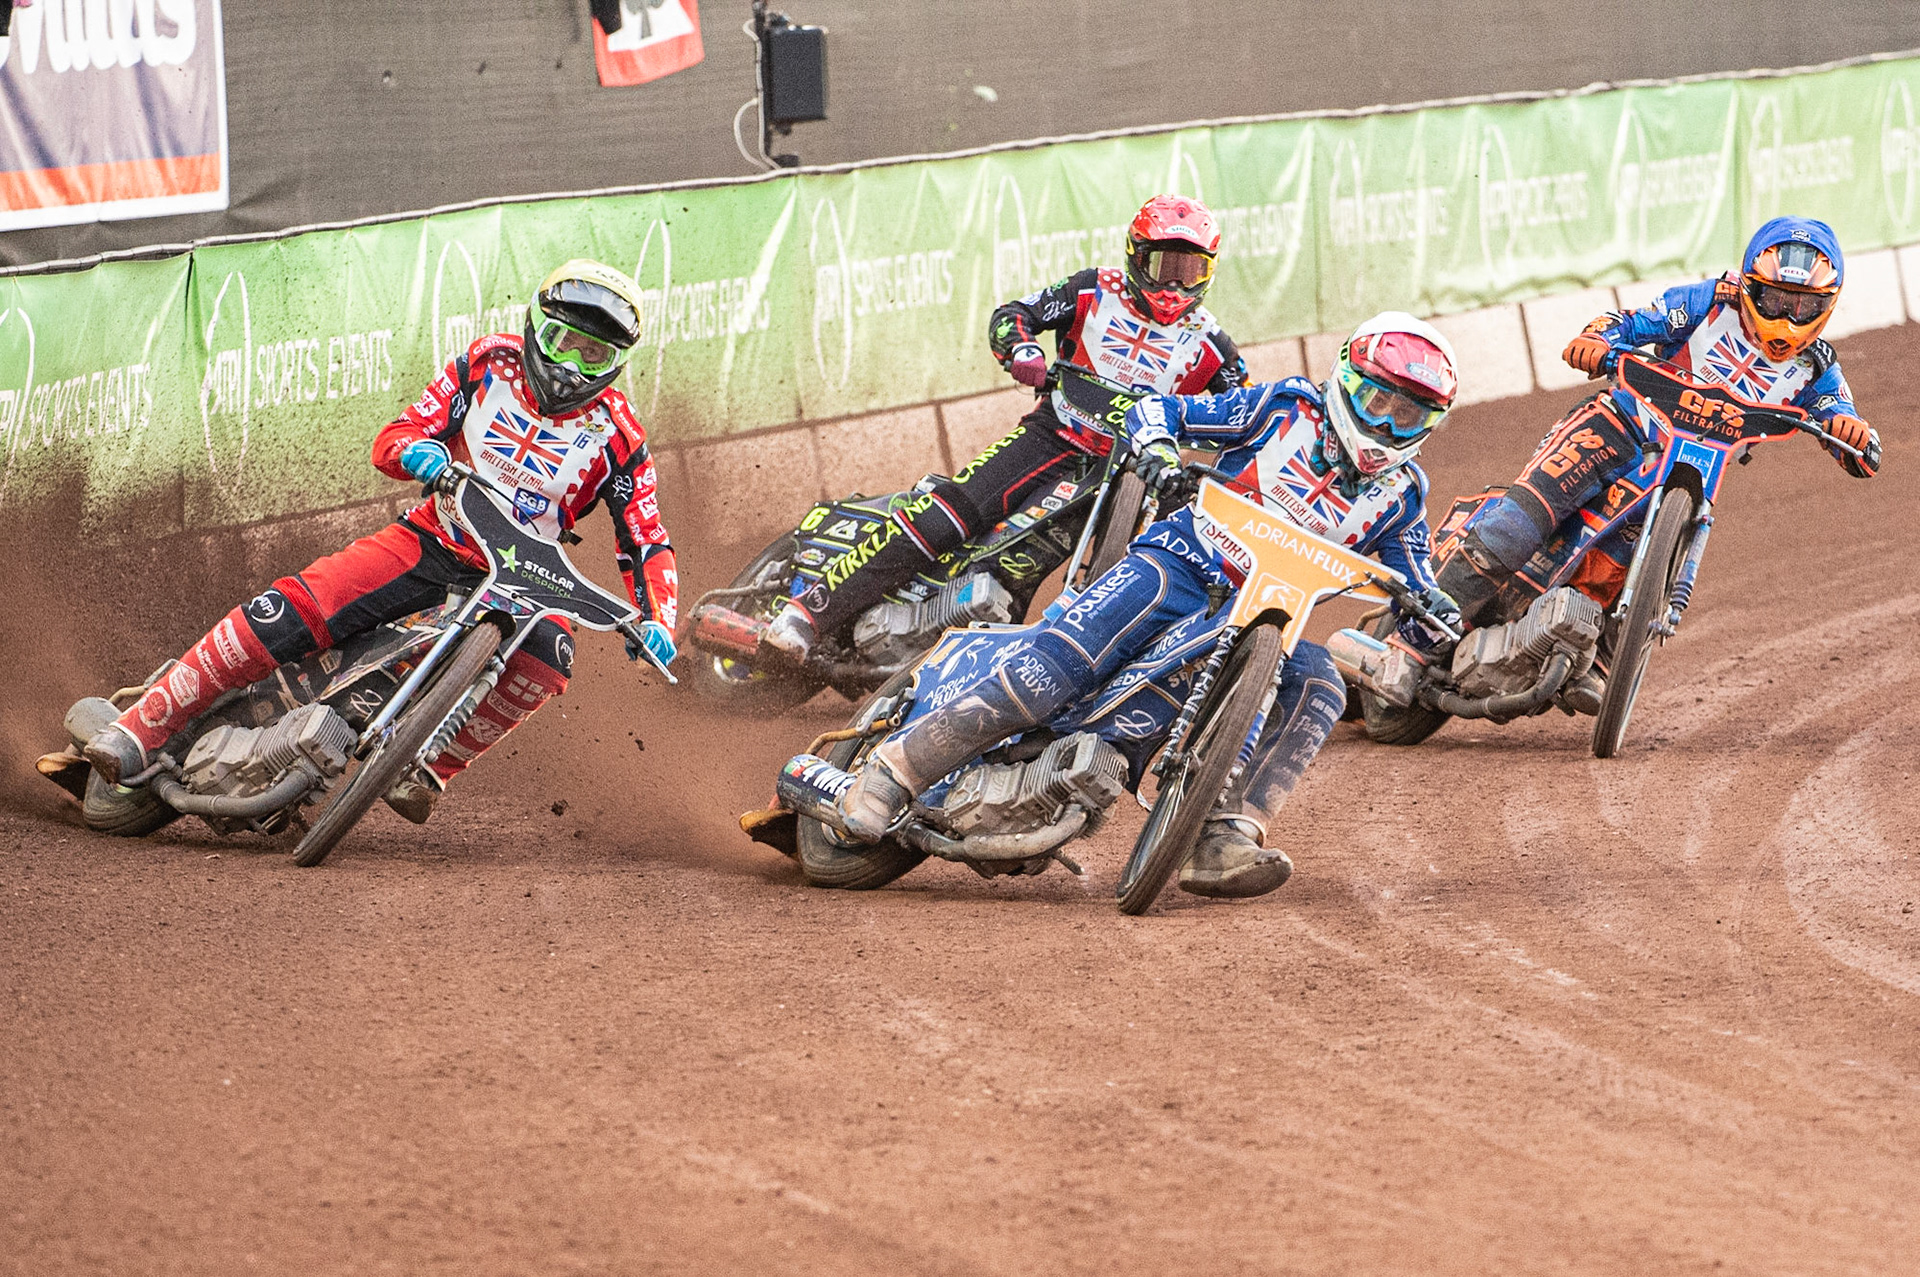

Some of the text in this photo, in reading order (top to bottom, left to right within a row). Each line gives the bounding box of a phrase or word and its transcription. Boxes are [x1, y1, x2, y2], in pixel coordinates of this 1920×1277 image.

[1715, 282, 1740, 295] CF
[1784, 269, 1806, 277] BELL
[1177, 332, 1193, 346] 17
[255, 337, 321, 410] SPORTS
[325, 329, 393, 400] EVENTS
[1099, 352, 1158, 384] BRITISH FINAL
[1114, 371, 1135, 385] 2019
[21, 374, 87, 451] SPORTS
[84, 362, 153, 437] EVENTS
[1679, 389, 1746, 428] CFS
[1672, 410, 1743, 439] FILTRATION
[573, 432, 592, 450] 16
[1540, 427, 1605, 479] CFS
[480, 449, 545, 491] BRITISH FINAL
[497, 472, 519, 489] 2019
[1559, 447, 1619, 494] FILTRATION
[517, 490, 547, 512] SGB
[1059, 484, 1076, 495] NGK
[800, 506, 830, 531] 6
[1271, 484, 1308, 520] BRITISH
[1304, 510, 1329, 537] FINAL
[1150, 530, 1233, 588] ADRIA
[520, 569, 572, 599] DESPATCH
[522, 560, 576, 592] STELLAR
[257, 595, 276, 617] ATPI
[1063, 563, 1135, 632] poultec
[923, 670, 980, 704] ADRIAN
[1015, 666, 1046, 698] FLUX
[1018, 654, 1061, 697] ADRIAN
[930, 684, 965, 711] FLUX
